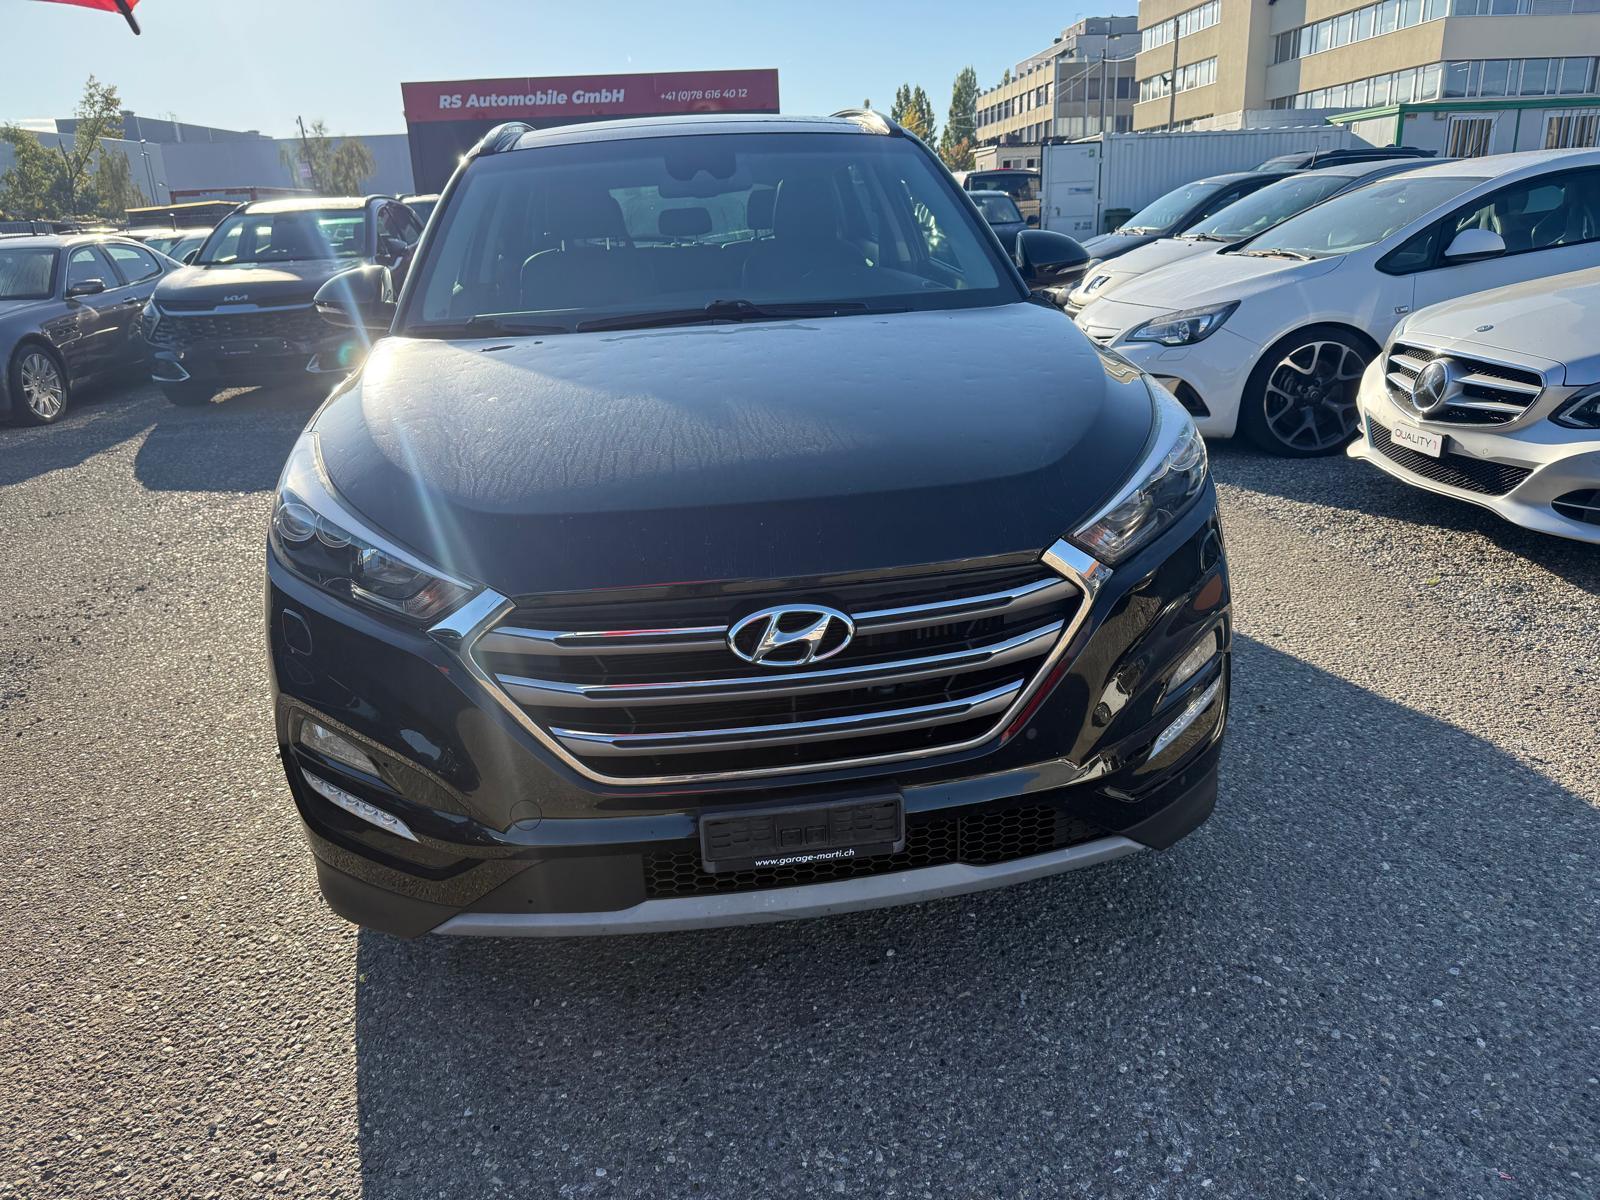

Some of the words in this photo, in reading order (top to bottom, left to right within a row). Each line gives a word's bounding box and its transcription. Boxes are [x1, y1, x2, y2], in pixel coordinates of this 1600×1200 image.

[439, 95, 462, 109] RS
[465, 90, 568, 108] Automobile
[572, 89, 625, 104] GmbH
[661, 91, 676, 101] +41
[678, 90, 703, 102] (0)78
[705, 89, 721, 99] 616
[723, 88, 736, 98] 40
[738, 88, 748, 98] 12
[1395, 428, 1432, 448] QUALITY
[755, 848, 855, 866] www.garage-marti.ch
